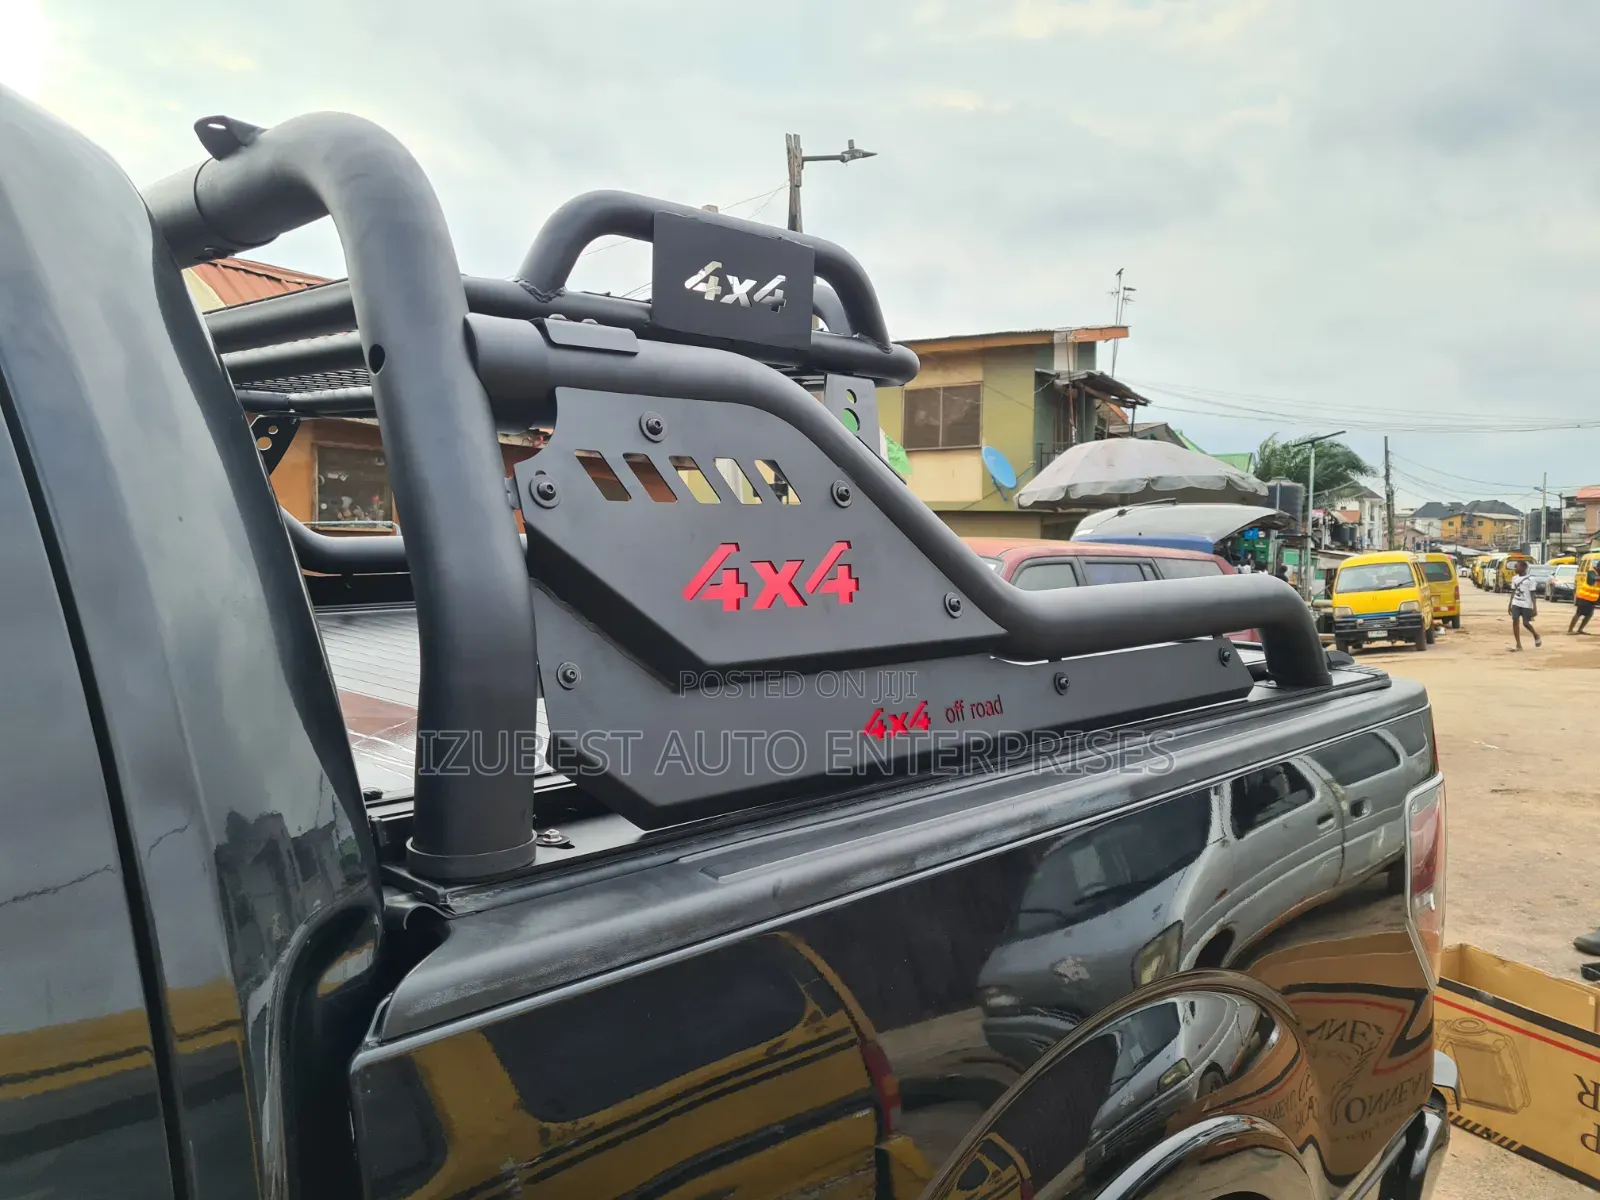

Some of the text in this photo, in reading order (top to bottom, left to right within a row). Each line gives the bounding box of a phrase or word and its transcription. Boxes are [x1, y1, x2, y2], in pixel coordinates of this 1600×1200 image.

[684, 260, 788, 314] 4x4
[682, 540, 860, 612] 4x4
[863, 694, 1004, 740] 4x4 off road
